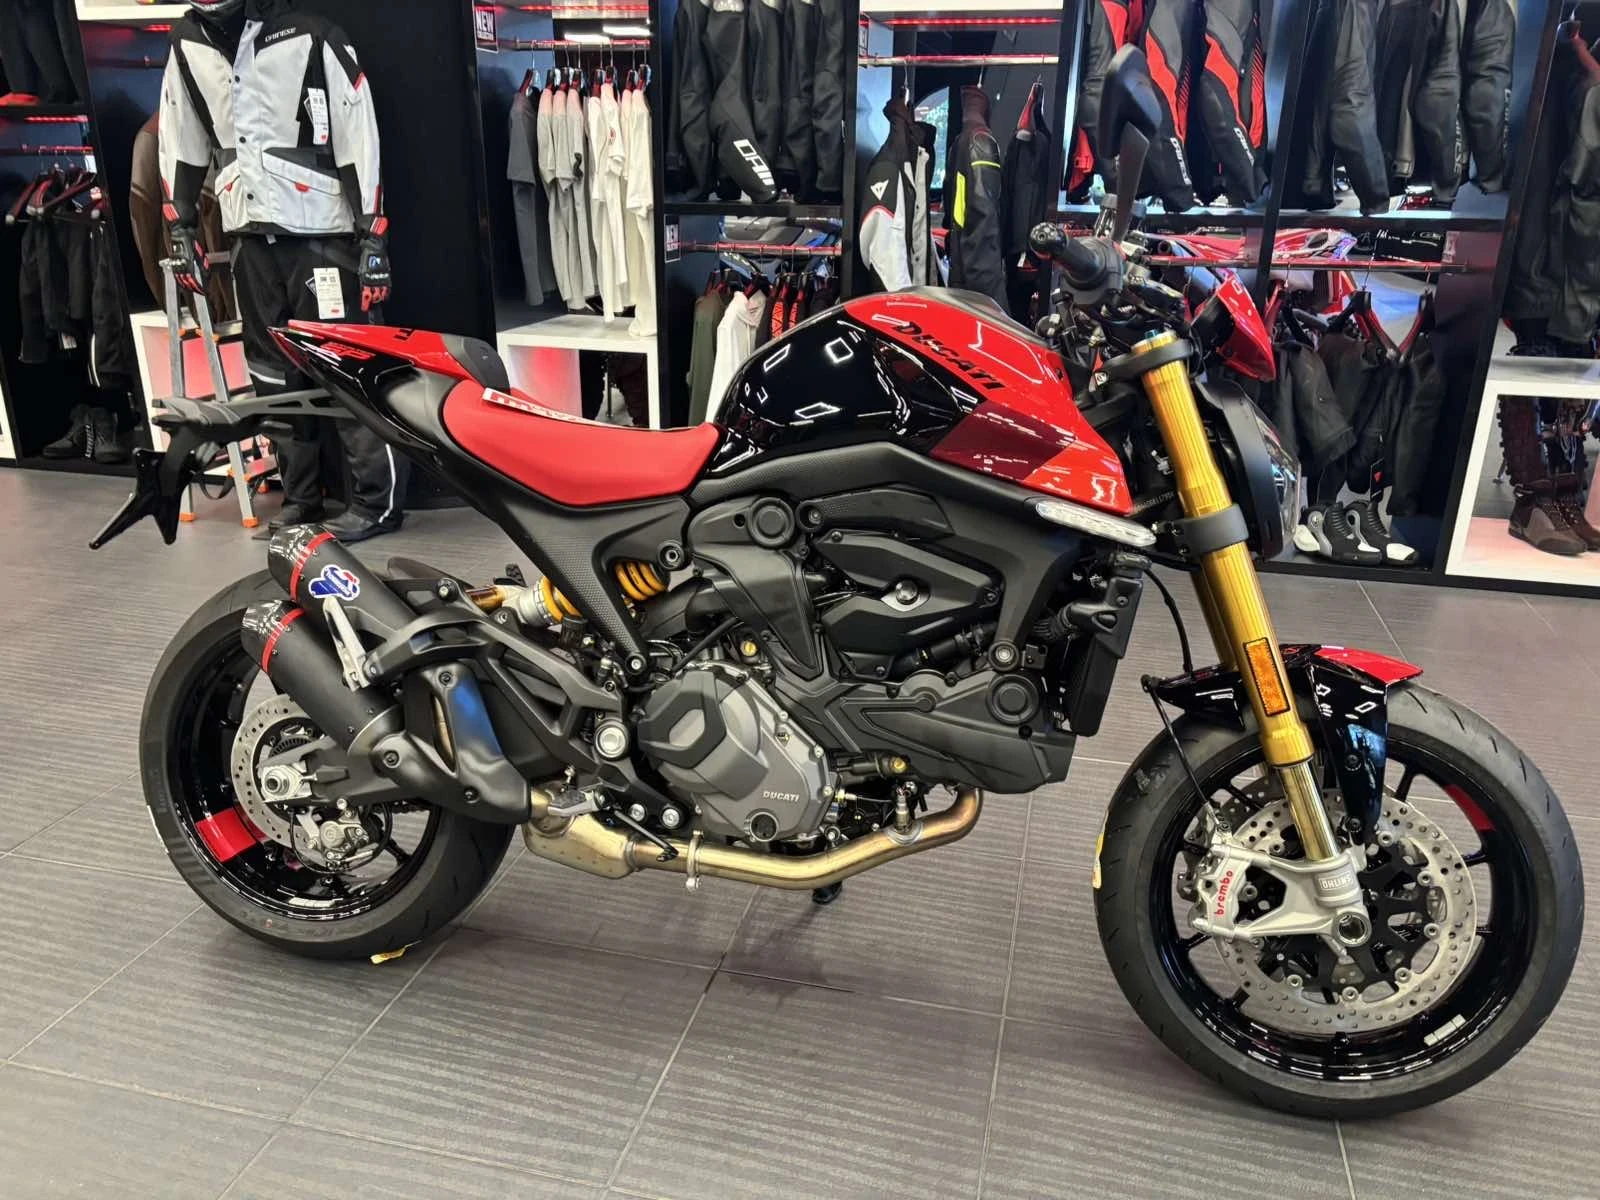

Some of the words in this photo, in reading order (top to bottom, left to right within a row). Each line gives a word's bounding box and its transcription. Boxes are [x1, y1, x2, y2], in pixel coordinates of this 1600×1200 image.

[476, 10, 494, 33] NEW
[763, 791, 800, 802] DUCATI
[1214, 870, 1234, 916] brembo
